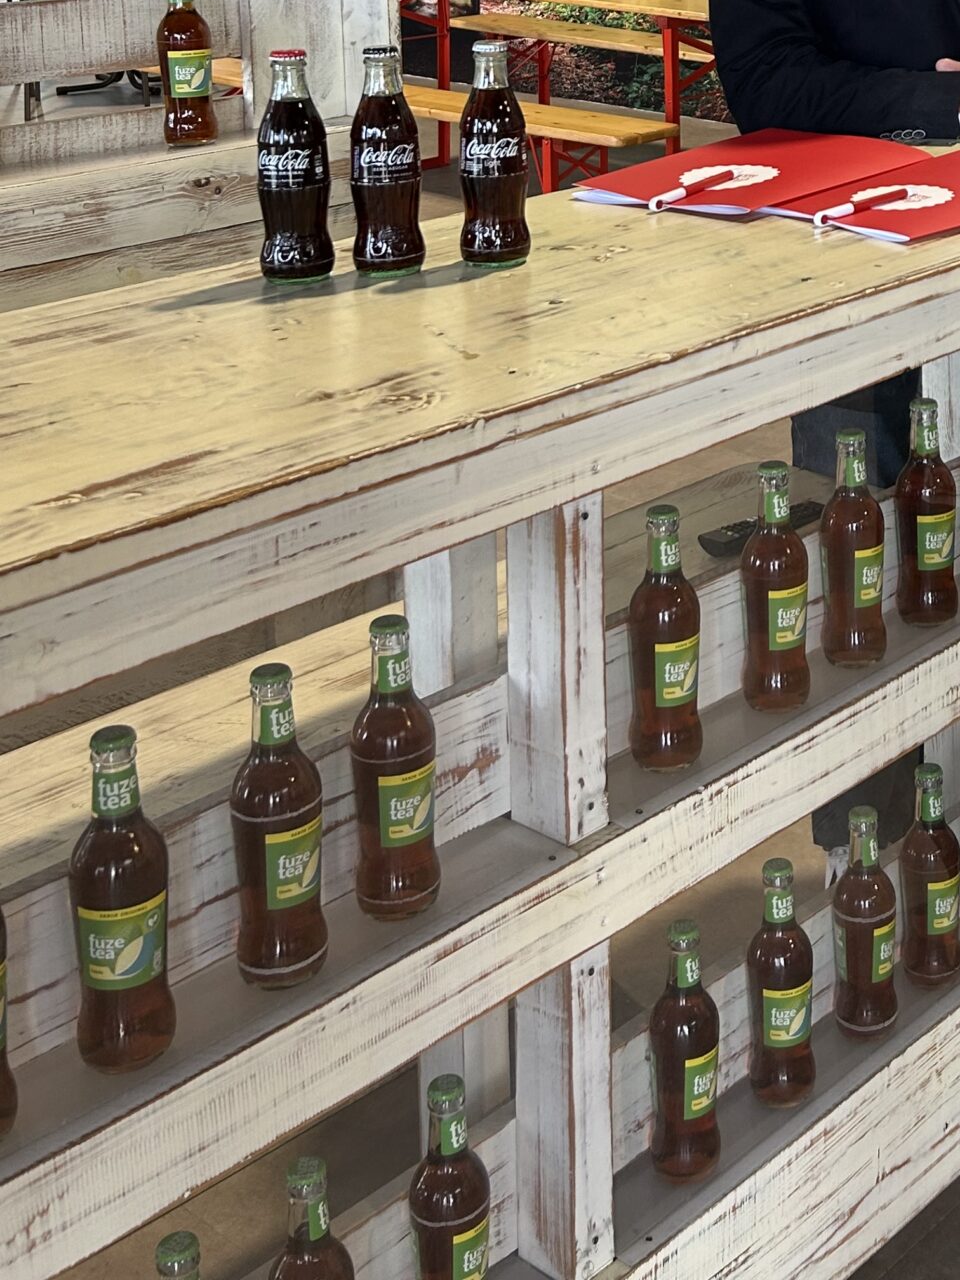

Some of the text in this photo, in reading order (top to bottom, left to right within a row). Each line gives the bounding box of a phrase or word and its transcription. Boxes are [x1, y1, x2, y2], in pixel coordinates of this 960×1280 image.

[174, 65, 196, 75] fuze
[175, 73, 192, 81] tea
[466, 136, 520, 159] Coca-Cola
[258, 148, 313, 170] Coca-Cola
[360, 142, 415, 167] Coca-Cola
[925, 531, 947, 543] fuze
[925, 540, 943, 550] tea
[863, 575, 878, 585] tea
[777, 607, 801, 620] fuze
[777, 617, 796, 628] tea
[664, 660, 690, 675] fuze
[664, 671, 685, 683] tea
[97, 774, 137, 798] fuze
[99, 792, 132, 810] tea
[390, 795, 421, 810] fuze
[390, 806, 414, 820] tea
[278, 851, 311, 868] fuze
[278, 864, 303, 880] tea
[772, 906, 793, 919] tea
[935, 904, 951, 915] tea
[88, 933, 125, 949] fuze
[89, 947, 115, 960] tea
[771, 1008, 797, 1020] fuze
[771, 1016, 791, 1026] tea
[693, 1080, 711, 1095] tea
[462, 1255, 483, 1273] tea
